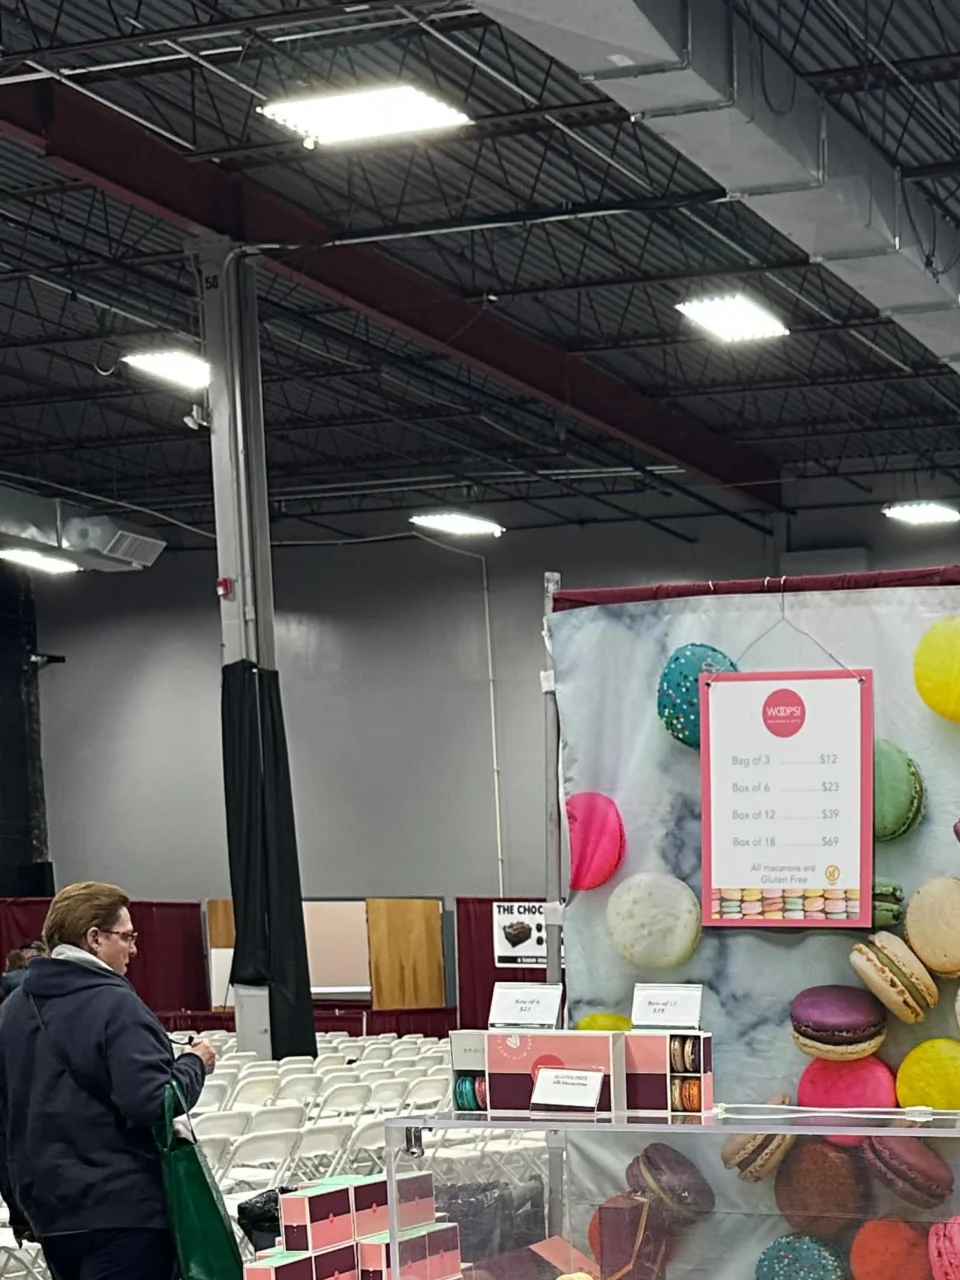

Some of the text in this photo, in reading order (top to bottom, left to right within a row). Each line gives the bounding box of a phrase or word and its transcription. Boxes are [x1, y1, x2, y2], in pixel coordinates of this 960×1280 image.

[732, 754, 838, 768] Bag of 3 $12
[732, 782, 839, 792] Box of 6 $23
[732, 809, 839, 820] Box of 12 $39
[732, 836, 839, 847] Box of 18 $69
[750, 863, 761, 872] All
[803, 865, 816, 873] are
[761, 874, 808, 884] Gluten Free
[496, 904, 543, 915] THE CHOC
